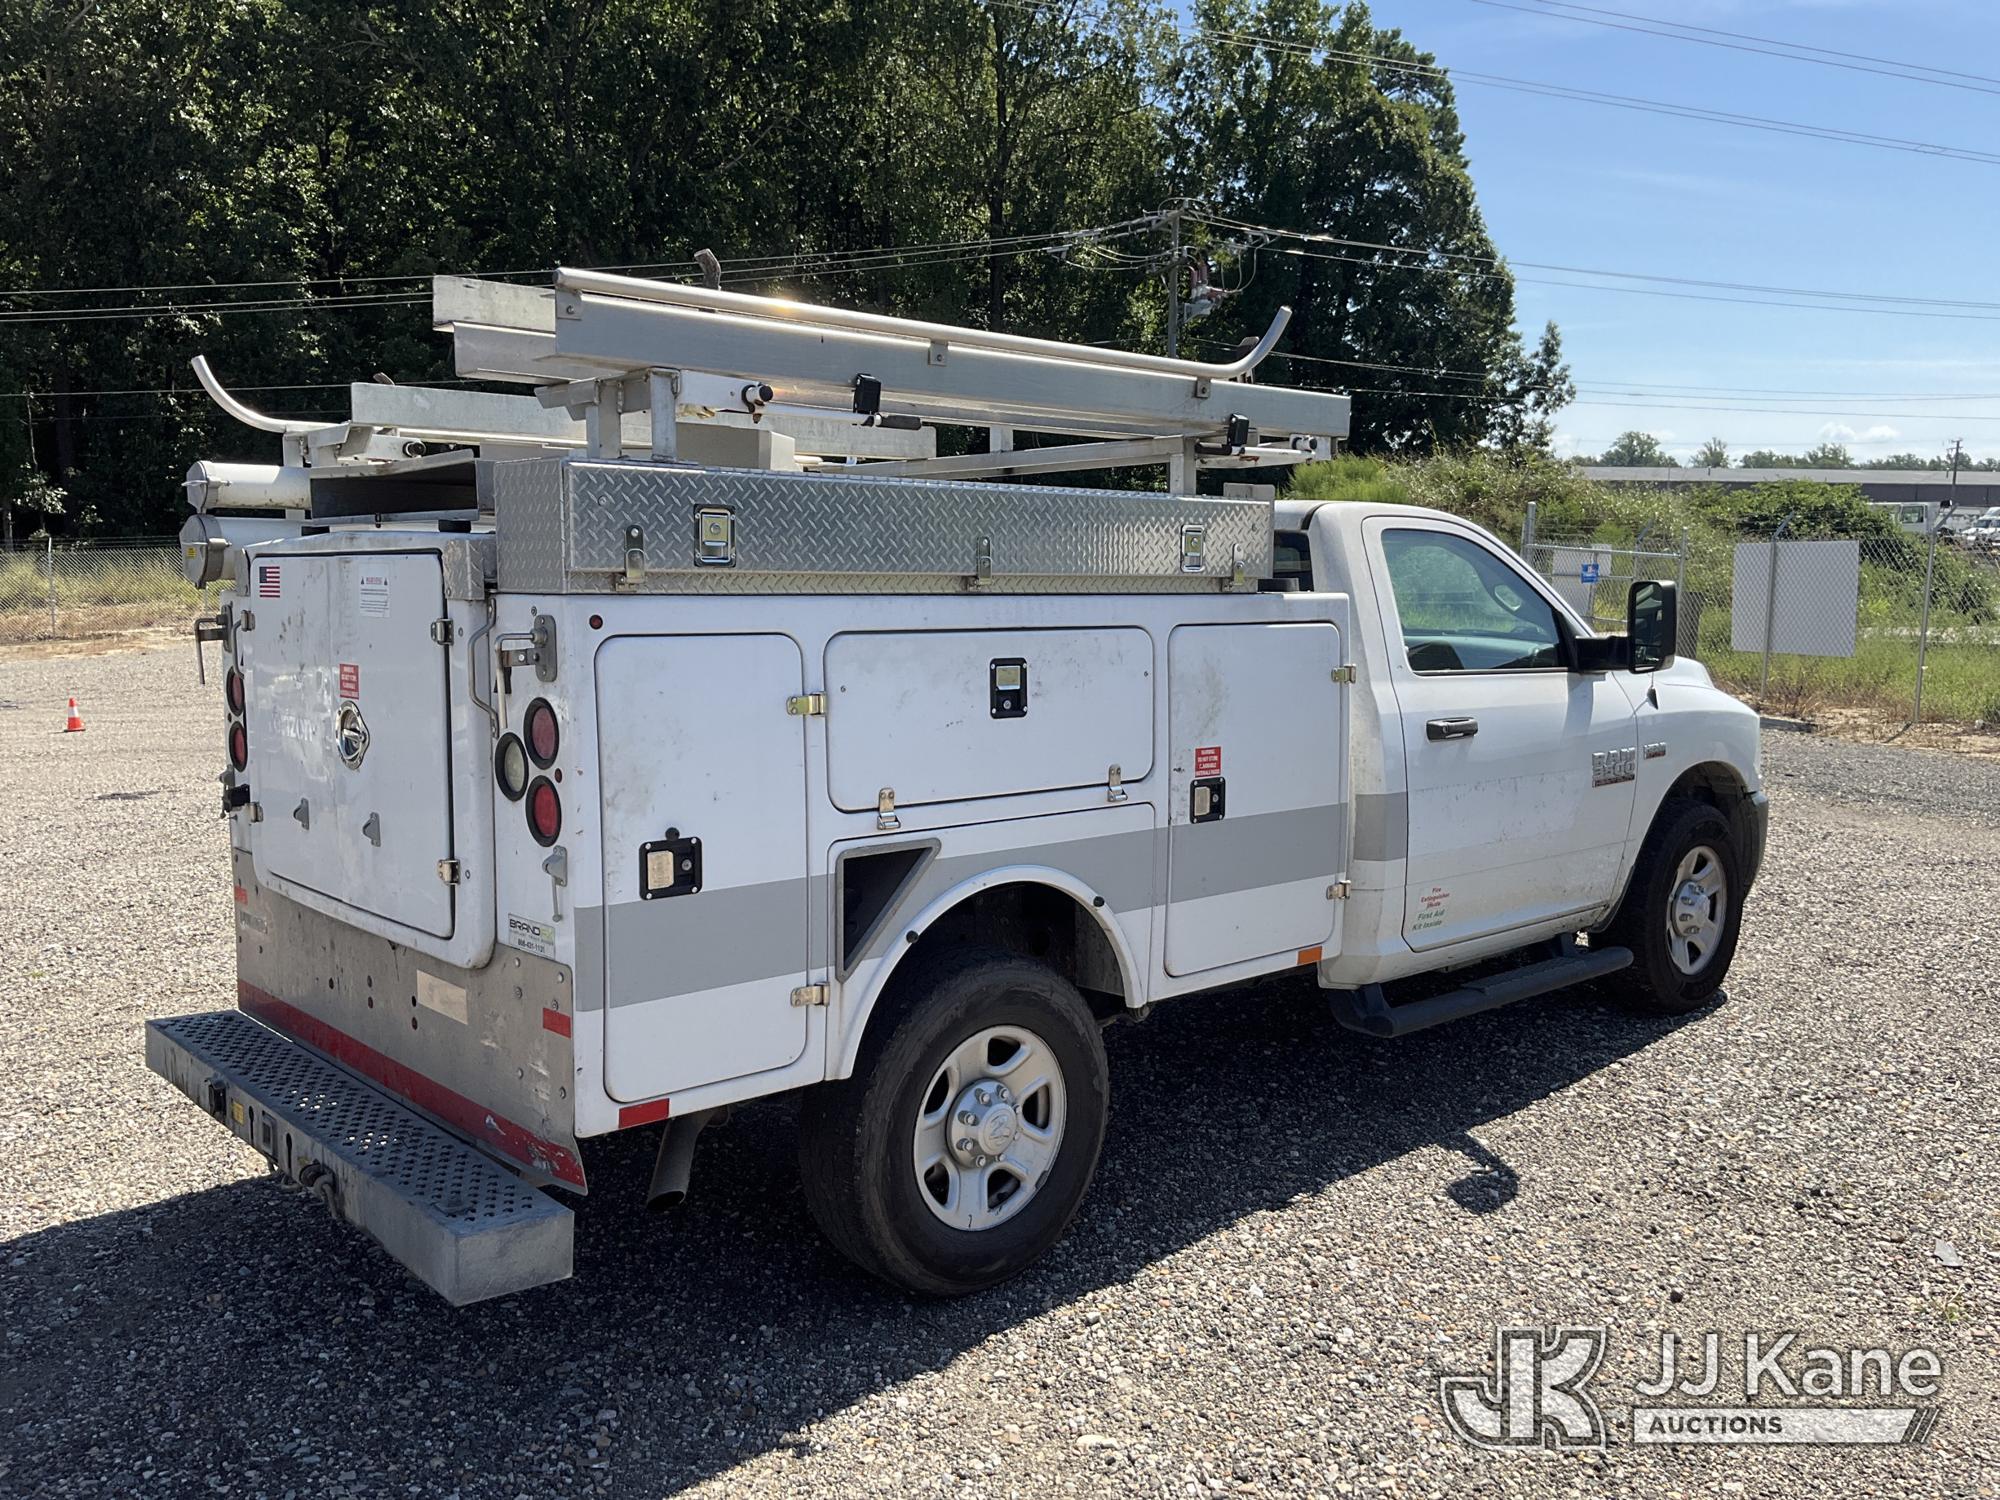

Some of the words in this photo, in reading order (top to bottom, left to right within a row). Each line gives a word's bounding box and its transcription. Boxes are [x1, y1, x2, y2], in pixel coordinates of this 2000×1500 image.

[1417, 911, 1433, 921] First
[1433, 909, 1445, 917] Aid
[1423, 920, 1442, 929] Inside
